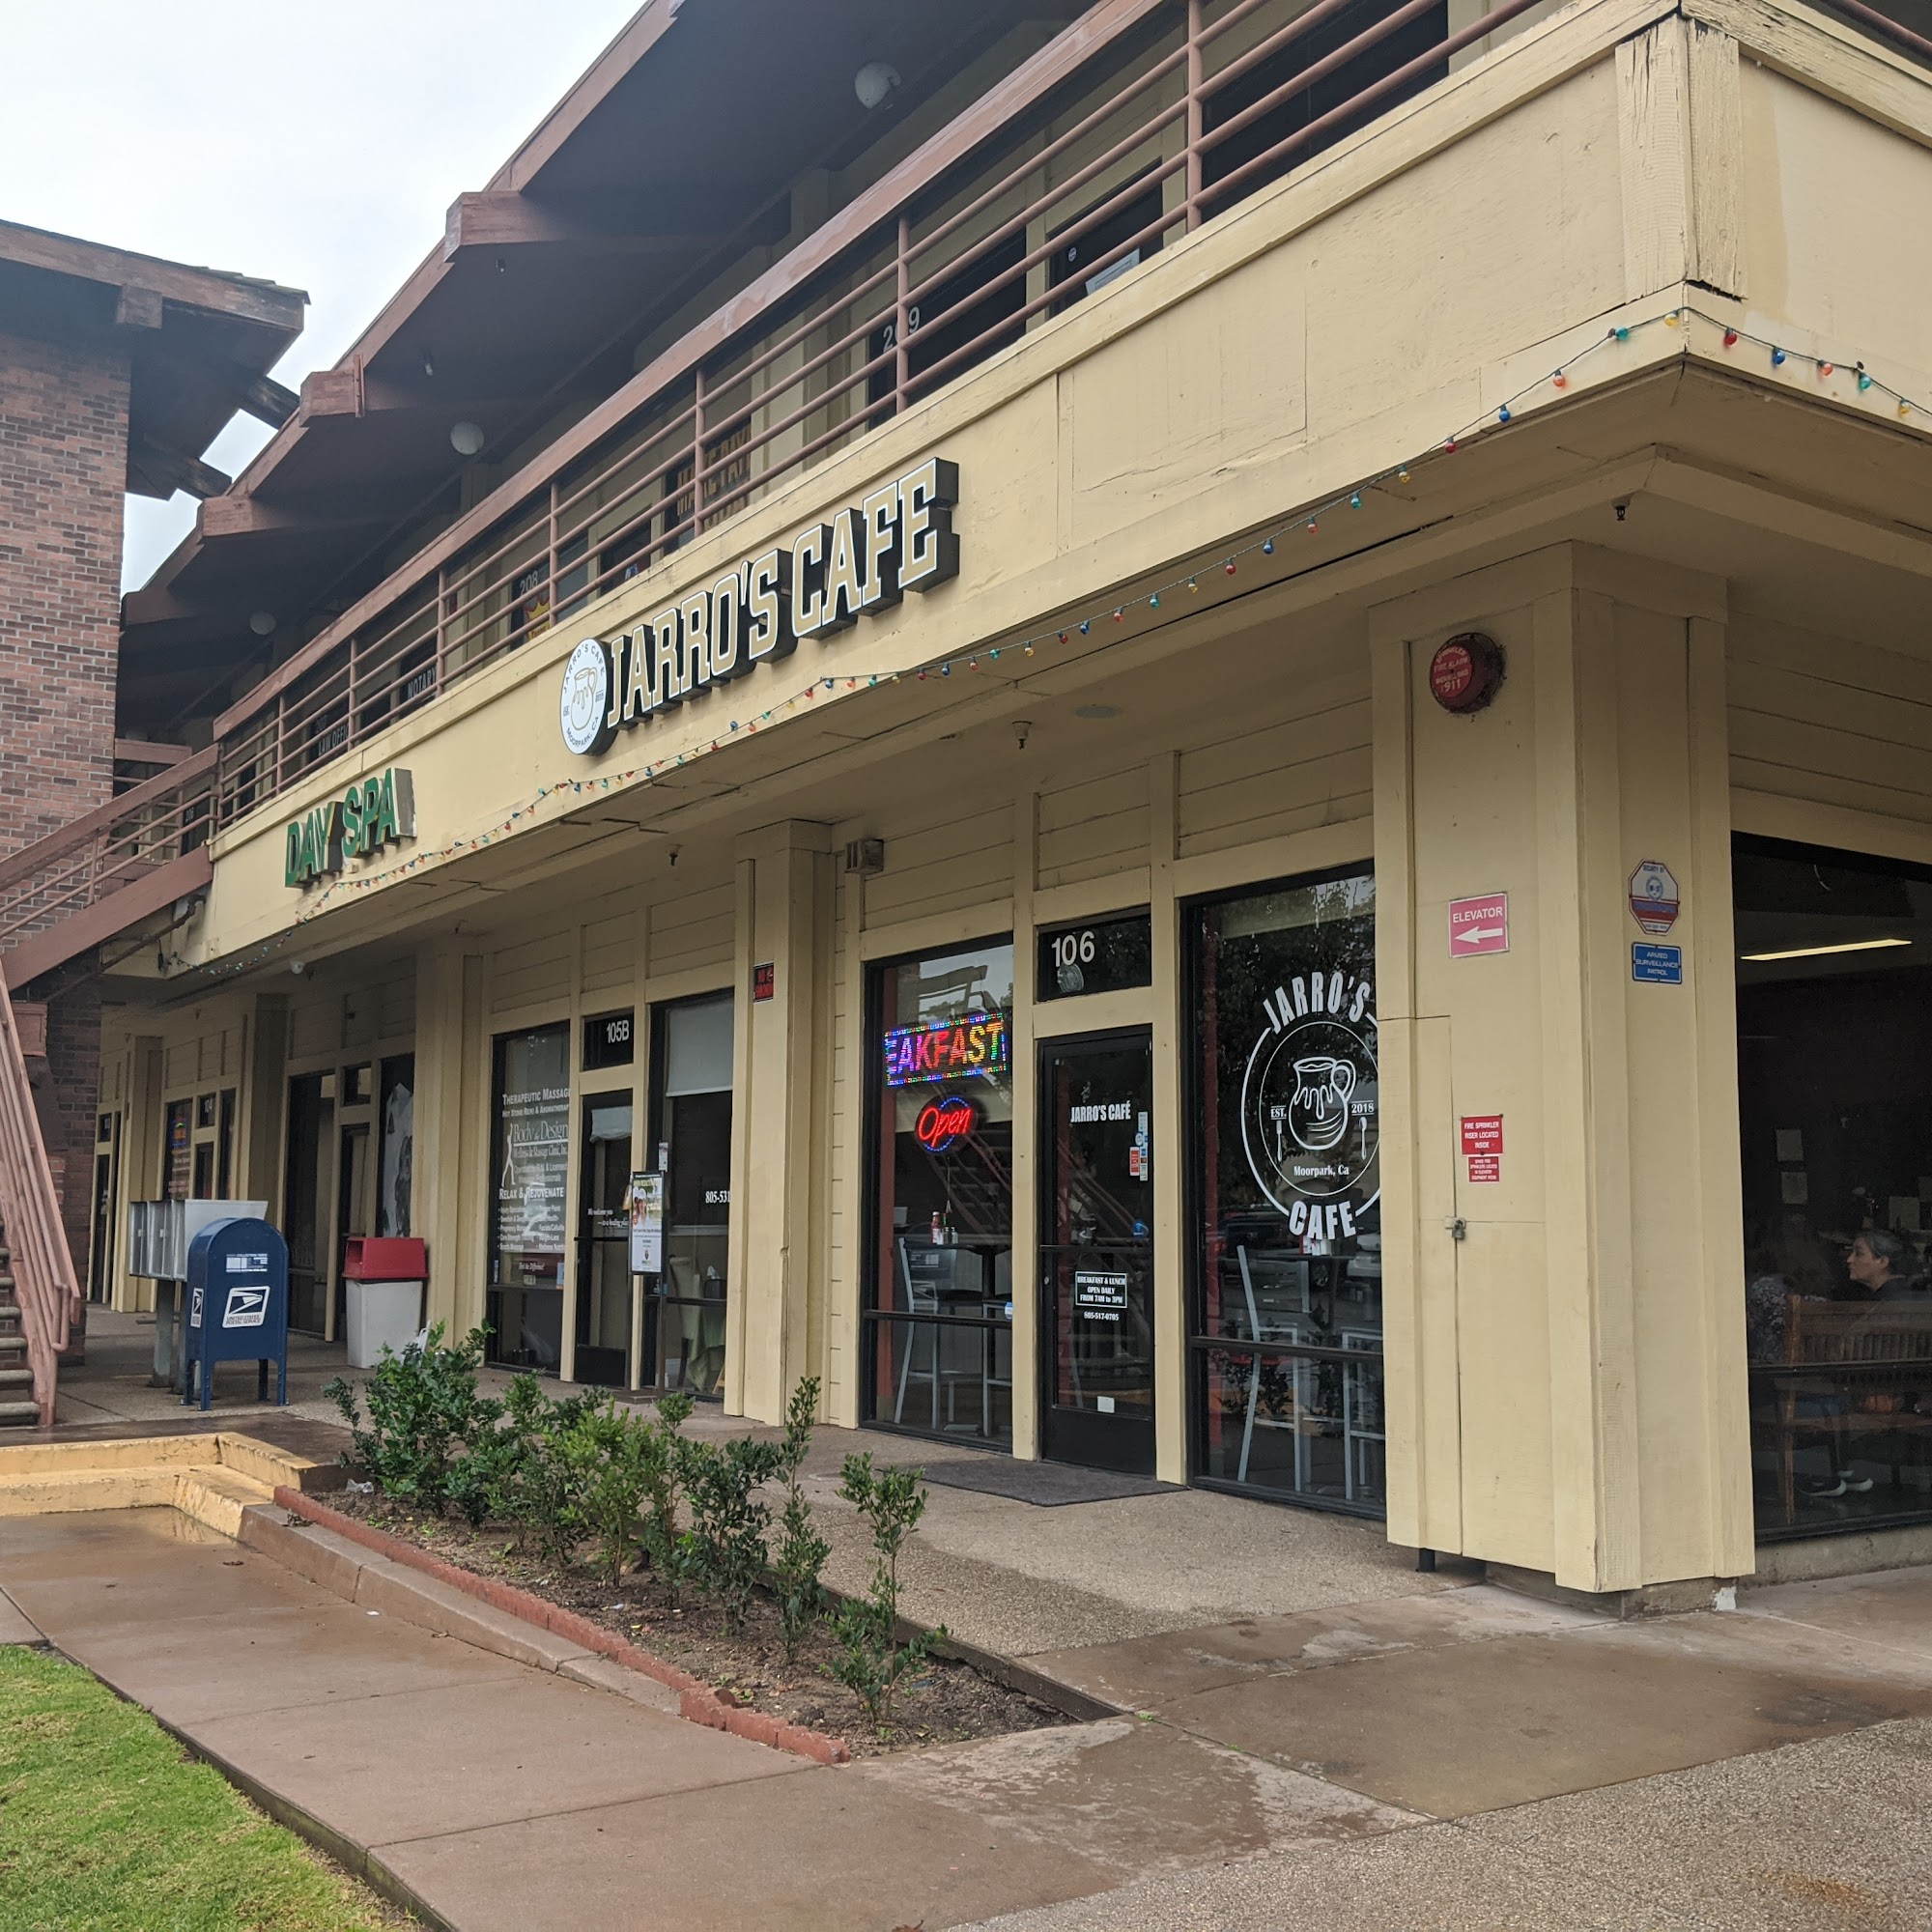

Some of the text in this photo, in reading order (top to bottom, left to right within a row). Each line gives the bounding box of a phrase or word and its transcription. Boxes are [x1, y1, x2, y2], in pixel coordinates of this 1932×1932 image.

[883, 306, 920, 354] 29
[608, 549, 779, 728] JARRO'S
[792, 458, 937, 638] CAFE
[407, 668, 436, 698] NOTARY
[1444, 679, 1461, 693] 911
[285, 768, 400, 888] DAY SPA
[1452, 906, 1503, 923] ELEVATOR
[1051, 930, 1095, 967] 106
[1635, 958, 1679, 969] SURVEILLANCE
[1263, 971, 1372, 1034] JARRO'S
[607, 1019, 629, 1043] 105B
[1070, 1100, 1131, 1122] JARRO'S CAFÉ
[1270, 1103, 1374, 1118] EST. 2018
[918, 1107, 972, 1148] Open
[1293, 1165, 1350, 1178] Moorpark, Ca
[1288, 1200, 1357, 1240] CAFE
